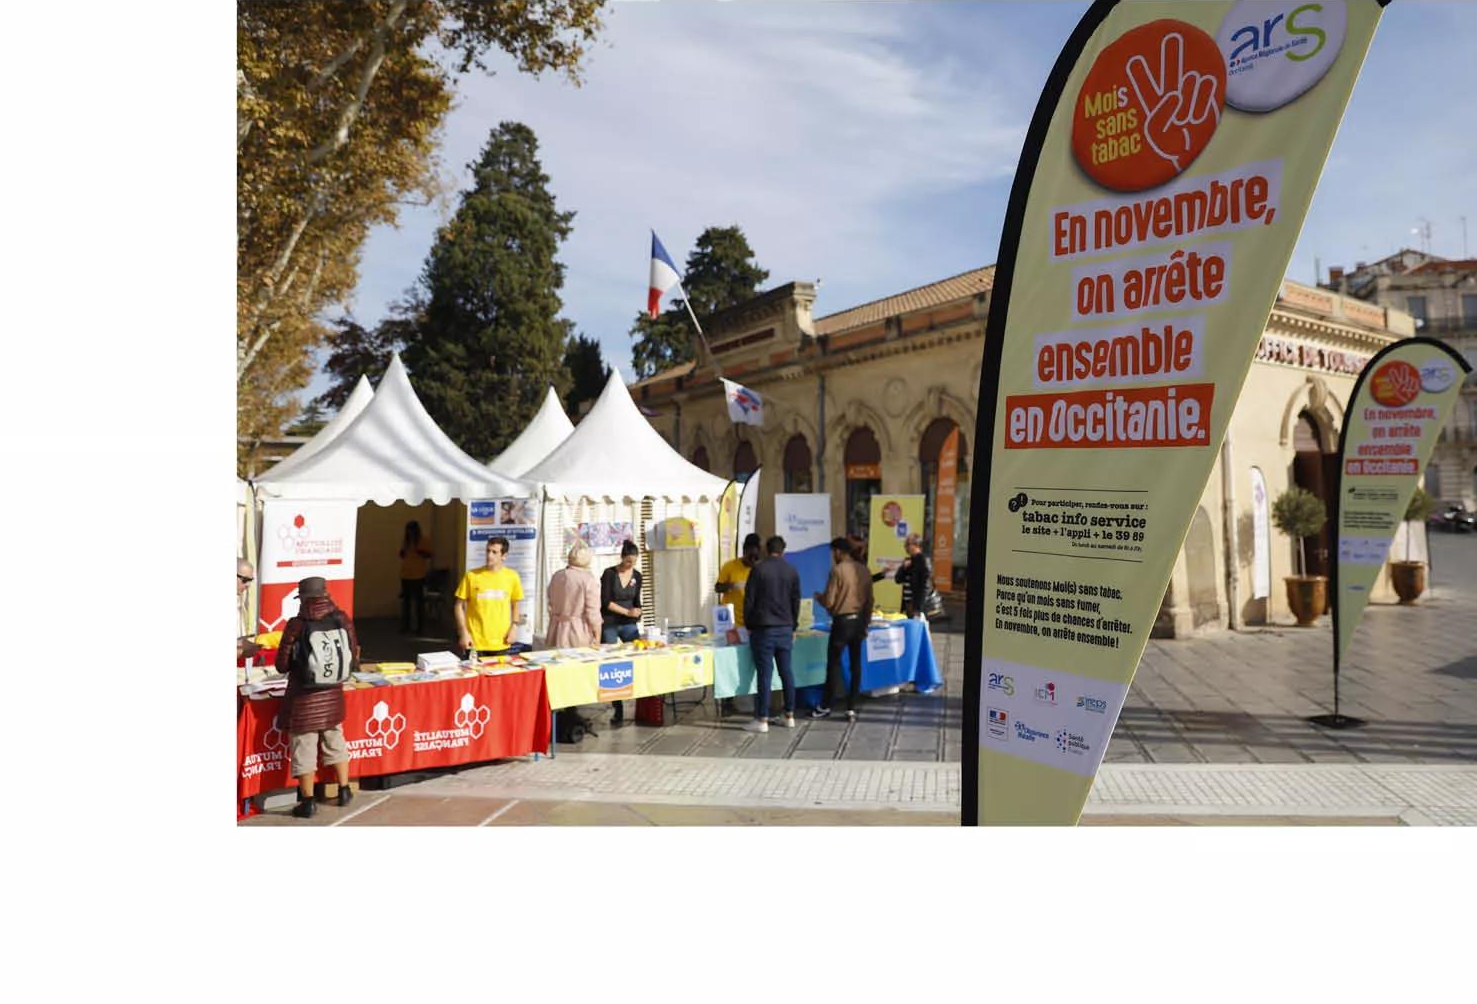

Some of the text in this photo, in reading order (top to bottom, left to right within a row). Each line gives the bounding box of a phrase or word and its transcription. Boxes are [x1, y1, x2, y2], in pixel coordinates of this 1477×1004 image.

[1084, 84, 1128, 119] Mois
[1095, 107, 1138, 139] sans
[1091, 132, 1142, 165] tabac
[1054, 175, 1276, 257] En novembre,
[1077, 249, 1225, 315] on arrête
[1037, 325, 1192, 382] ensemble
[1010, 388, 1205, 443] en Occitanie.
[1022, 510, 1146, 528] tabac info service
[1047, 500, 1084, 509] participer,
[1021, 525, 1031, 534] le
[1032, 525, 1051, 535] site
[1060, 527, 1091, 540] l'appli
[1102, 530, 1112, 539] le
[1115, 531, 1130, 540] 39
[1132, 532, 1144, 541] 89
[997, 574, 1014, 586] Nous
[1015, 577, 1052, 591] soutenons
[1052, 581, 1077, 595] Moi(s)
[1078, 584, 1098, 596] sans
[996, 589, 1101, 614] Parce qu'un mois sans fumer,
[995, 618, 1003, 629] En
[1004, 620, 1040, 637] novembre,
[1041, 626, 1051, 637] on
[1052, 627, 1076, 642] arrête
[996, 603, 1133, 634] c'est 5 fois plus de chances d'arrêter.
